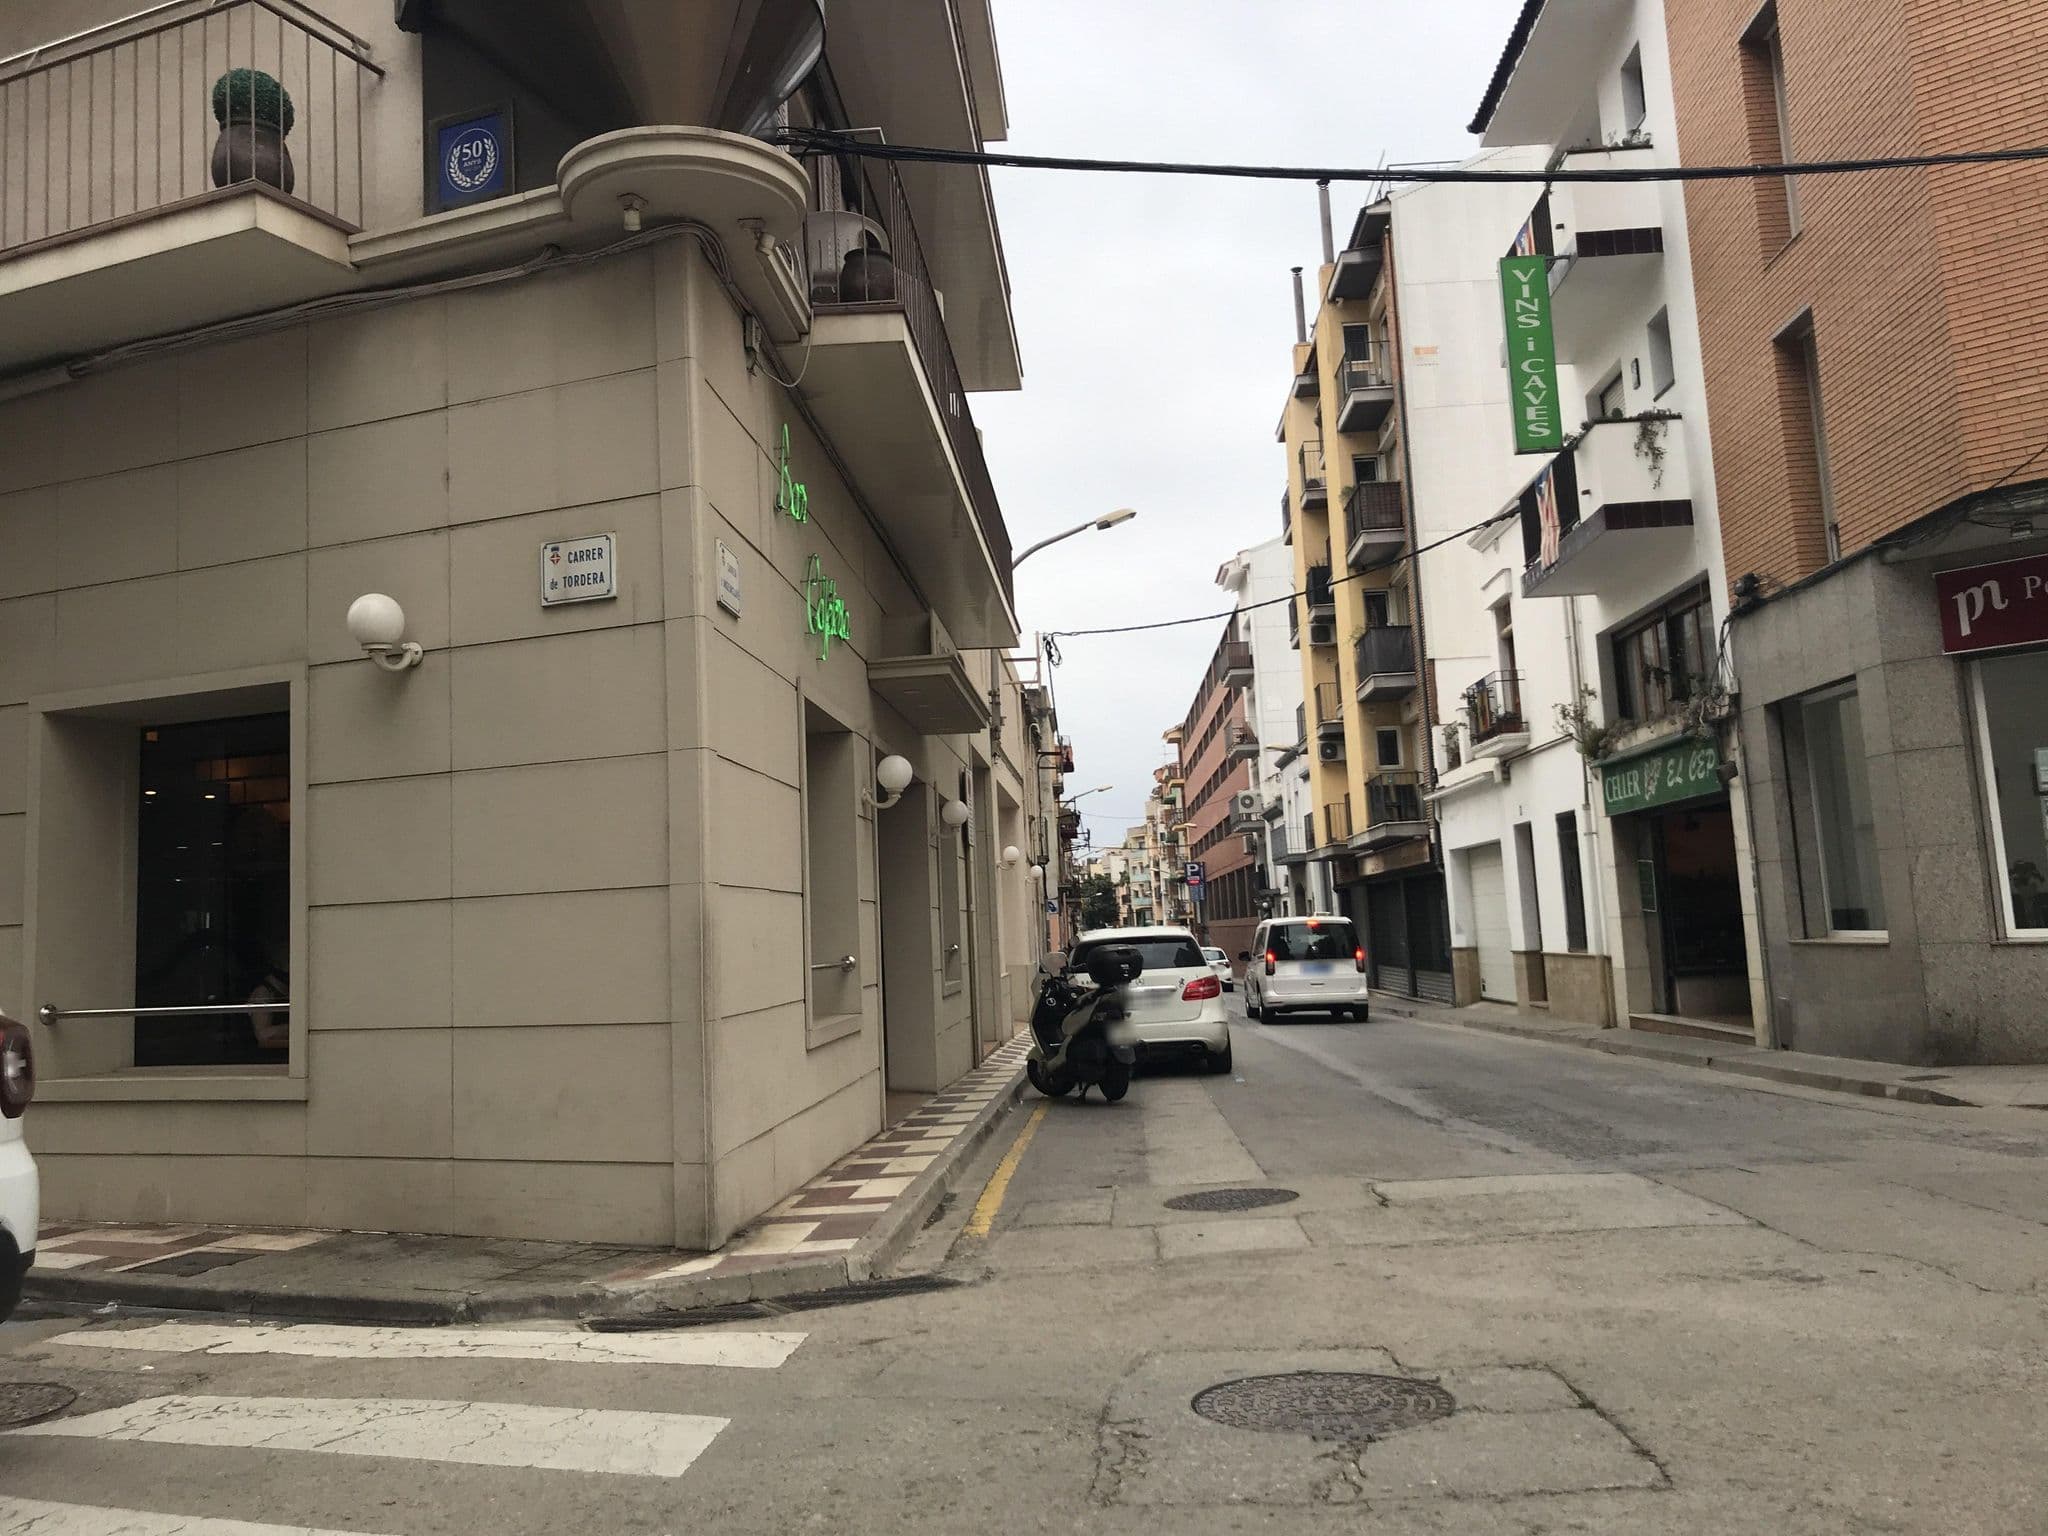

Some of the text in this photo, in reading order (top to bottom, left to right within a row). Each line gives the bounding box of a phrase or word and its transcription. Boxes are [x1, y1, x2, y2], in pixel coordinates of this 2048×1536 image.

[462, 140, 482, 161] 50
[1511, 268, 1552, 438] VINS i CAVES
[567, 547, 604, 564] CARRER
[549, 571, 605, 591] de TORDERA
[2021, 575, 2048, 600] P
[1605, 770, 1641, 803] CELLER
[1688, 747, 1716, 782] CEP
[1186, 863, 1199, 877] P
